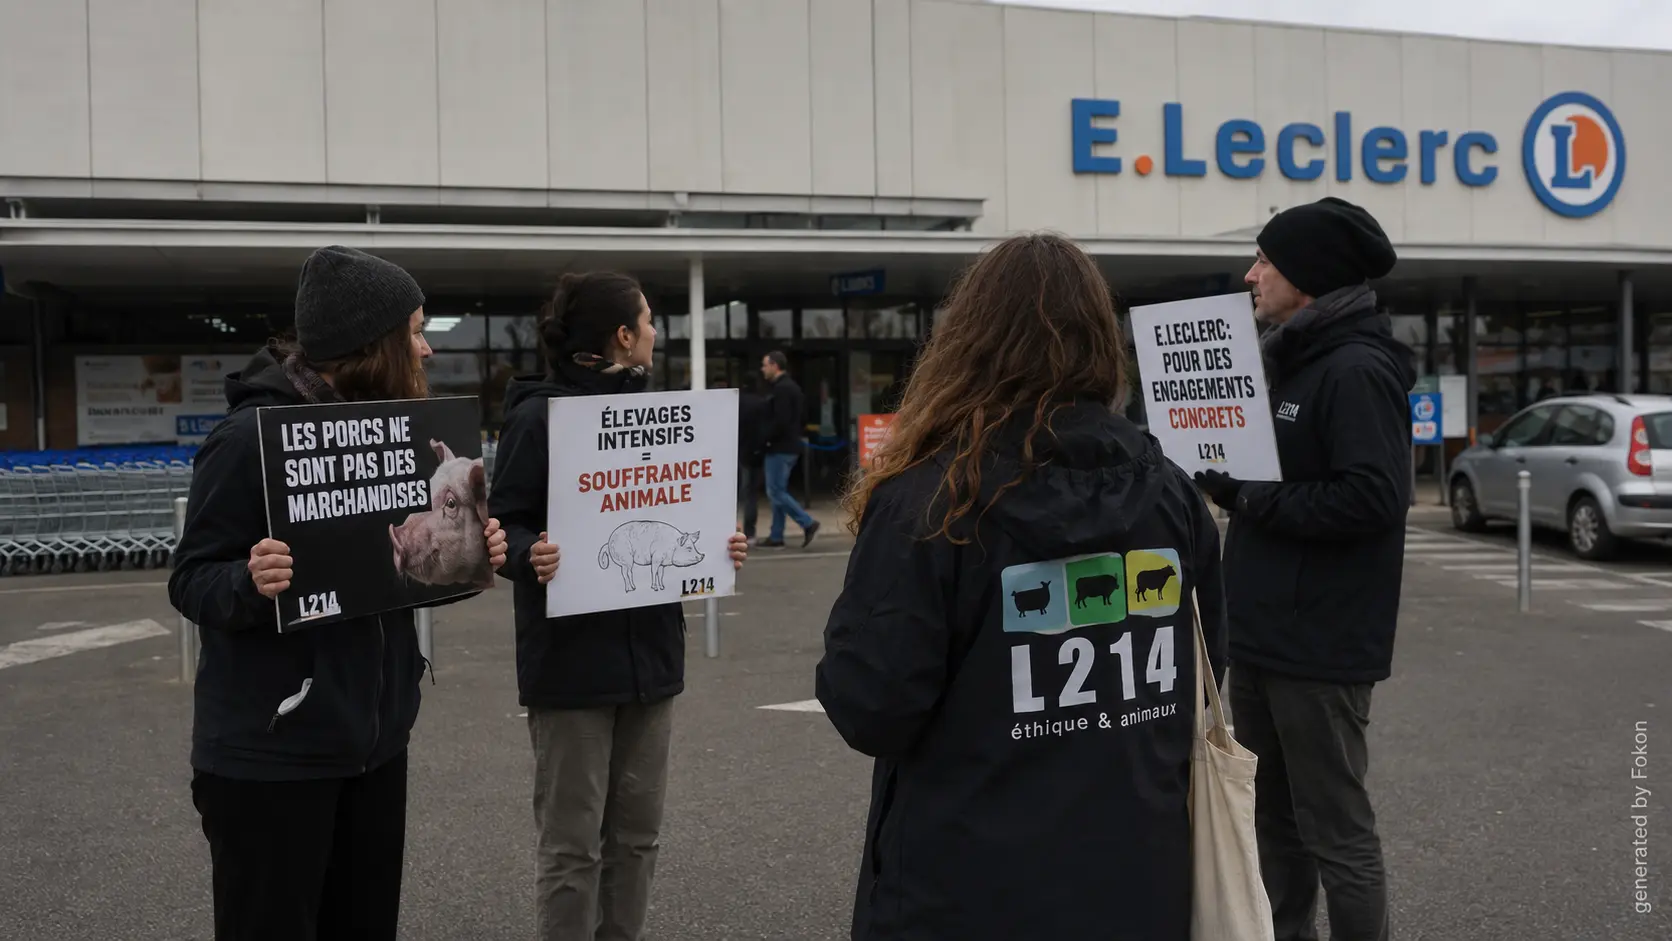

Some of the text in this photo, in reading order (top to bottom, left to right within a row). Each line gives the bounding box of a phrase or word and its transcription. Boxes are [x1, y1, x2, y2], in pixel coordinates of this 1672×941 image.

[1071, 98, 1498, 187] E.Leclerc
[1154, 318, 1232, 347] E.LECLERC:
[1162, 347, 1233, 374] POUR DES
[1151, 375, 1256, 403] ENGAGEMENTS
[601, 405, 692, 429] ÉLEVAGES
[1168, 405, 1246, 430] CONCRETS
[281, 416, 411, 452] LES PORCS NE
[597, 425, 695, 451] INTENSIFS
[641, 452, 651, 461] =
[1197, 443, 1226, 460] L214
[285, 448, 416, 487] SONT PAS DES
[578, 458, 713, 493] SOUFFRANCE
[287, 479, 428, 523] MARCHANDISES
[600, 483, 692, 513] ANIMALE
[681, 577, 715, 595] L214
[298, 591, 342, 618] L214
[1010, 625, 1177, 713] L214
[1011, 702, 1177, 740] éthique & animaux
